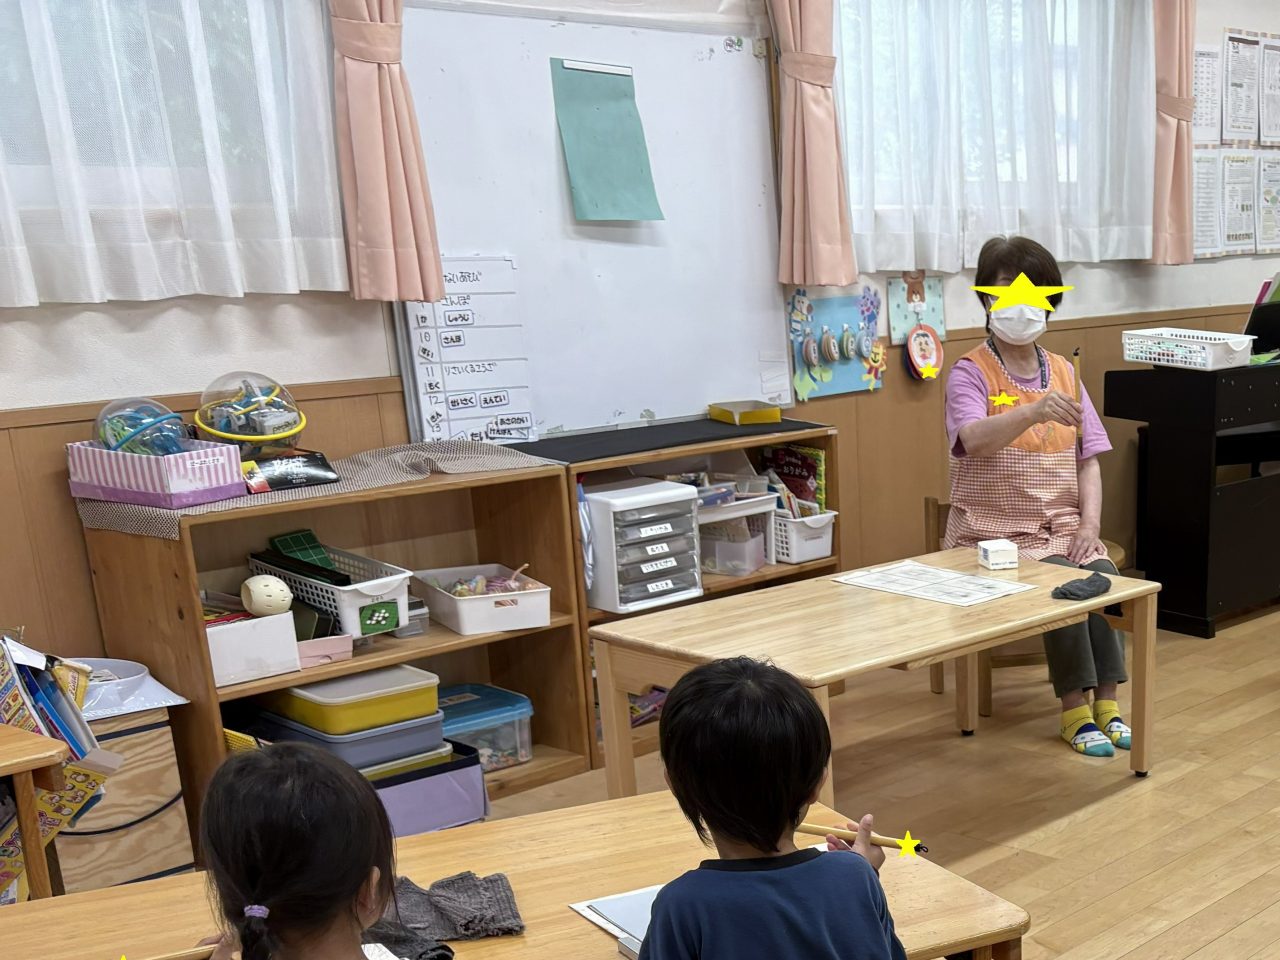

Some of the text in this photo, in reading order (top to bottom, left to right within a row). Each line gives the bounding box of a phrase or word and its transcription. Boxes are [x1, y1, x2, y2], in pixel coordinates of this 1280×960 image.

[447, 313, 470, 322] しゅうじ
[419, 332, 431, 343] 10
[426, 366, 434, 377] 11
[428, 395, 445, 405] 12
[450, 396, 475, 407] せいさく
[482, 394, 506, 405] えんてい
[498, 416, 529, 426] あさのかい
